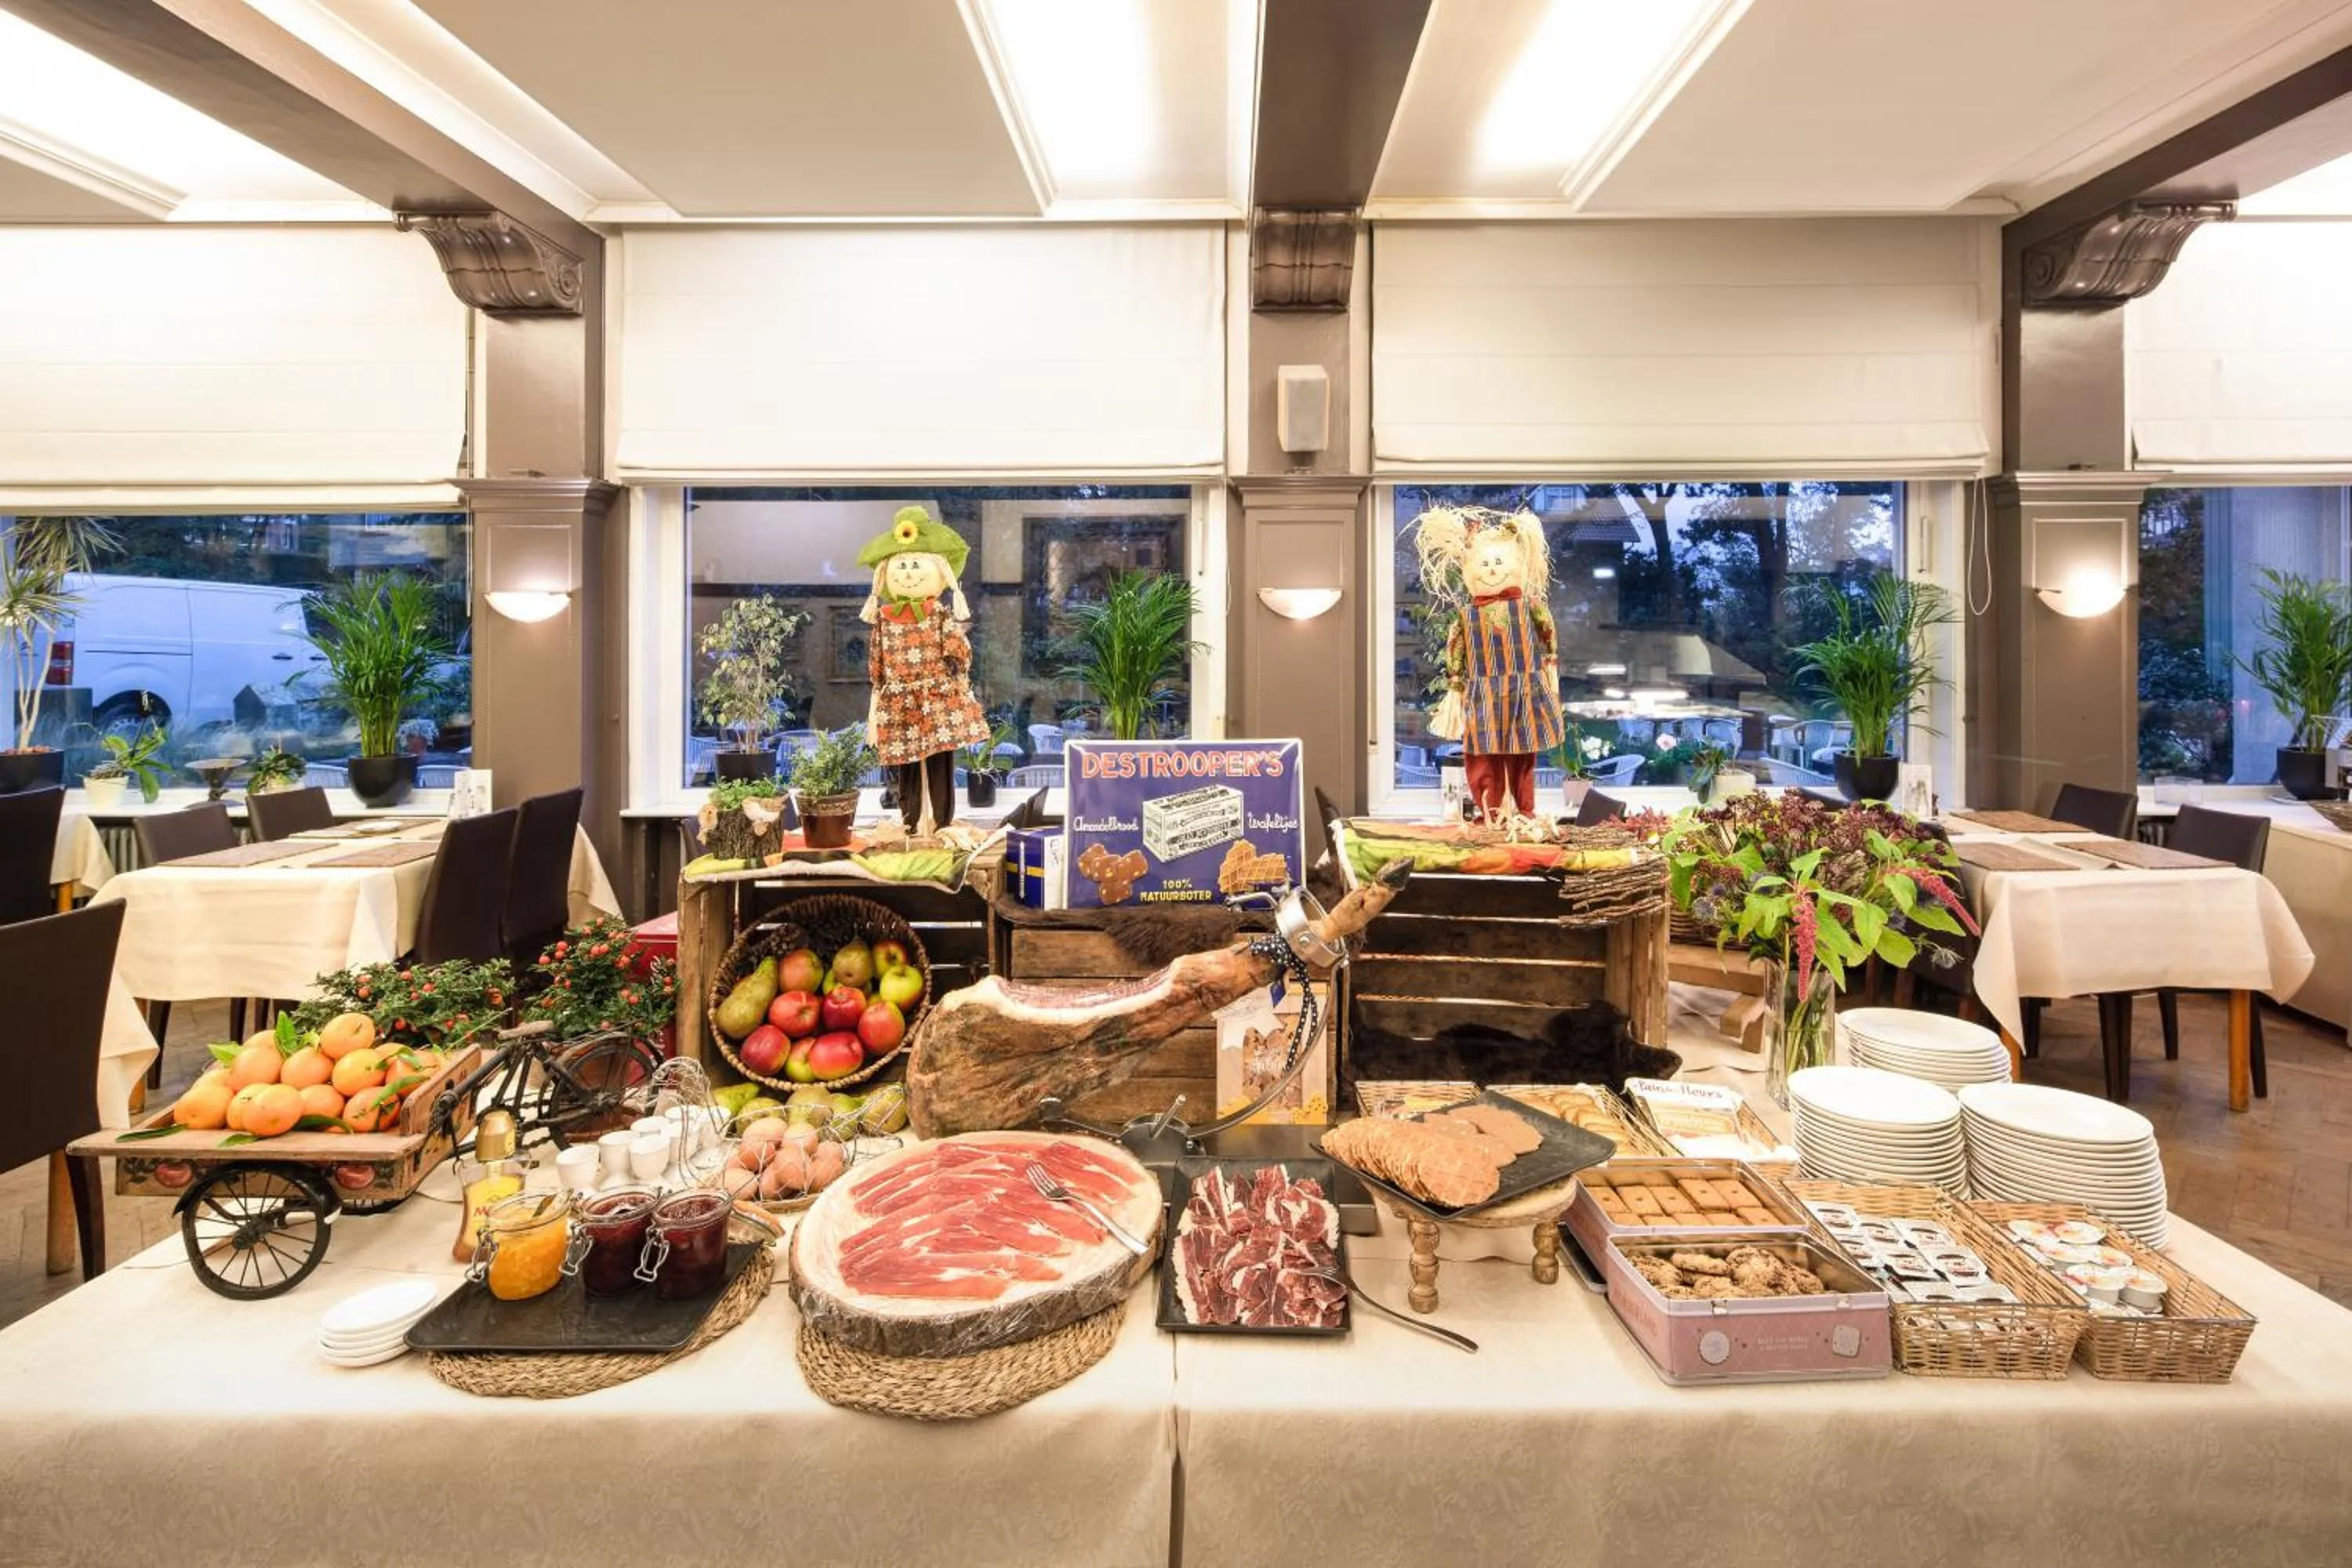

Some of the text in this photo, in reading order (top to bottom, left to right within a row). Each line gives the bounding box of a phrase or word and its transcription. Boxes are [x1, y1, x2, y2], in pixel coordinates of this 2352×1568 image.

[1081, 750, 1283, 779] DESTROOPER'S
[1163, 878, 1192, 889] 100%
[1140, 890, 1212, 902] NATUURBOTER
